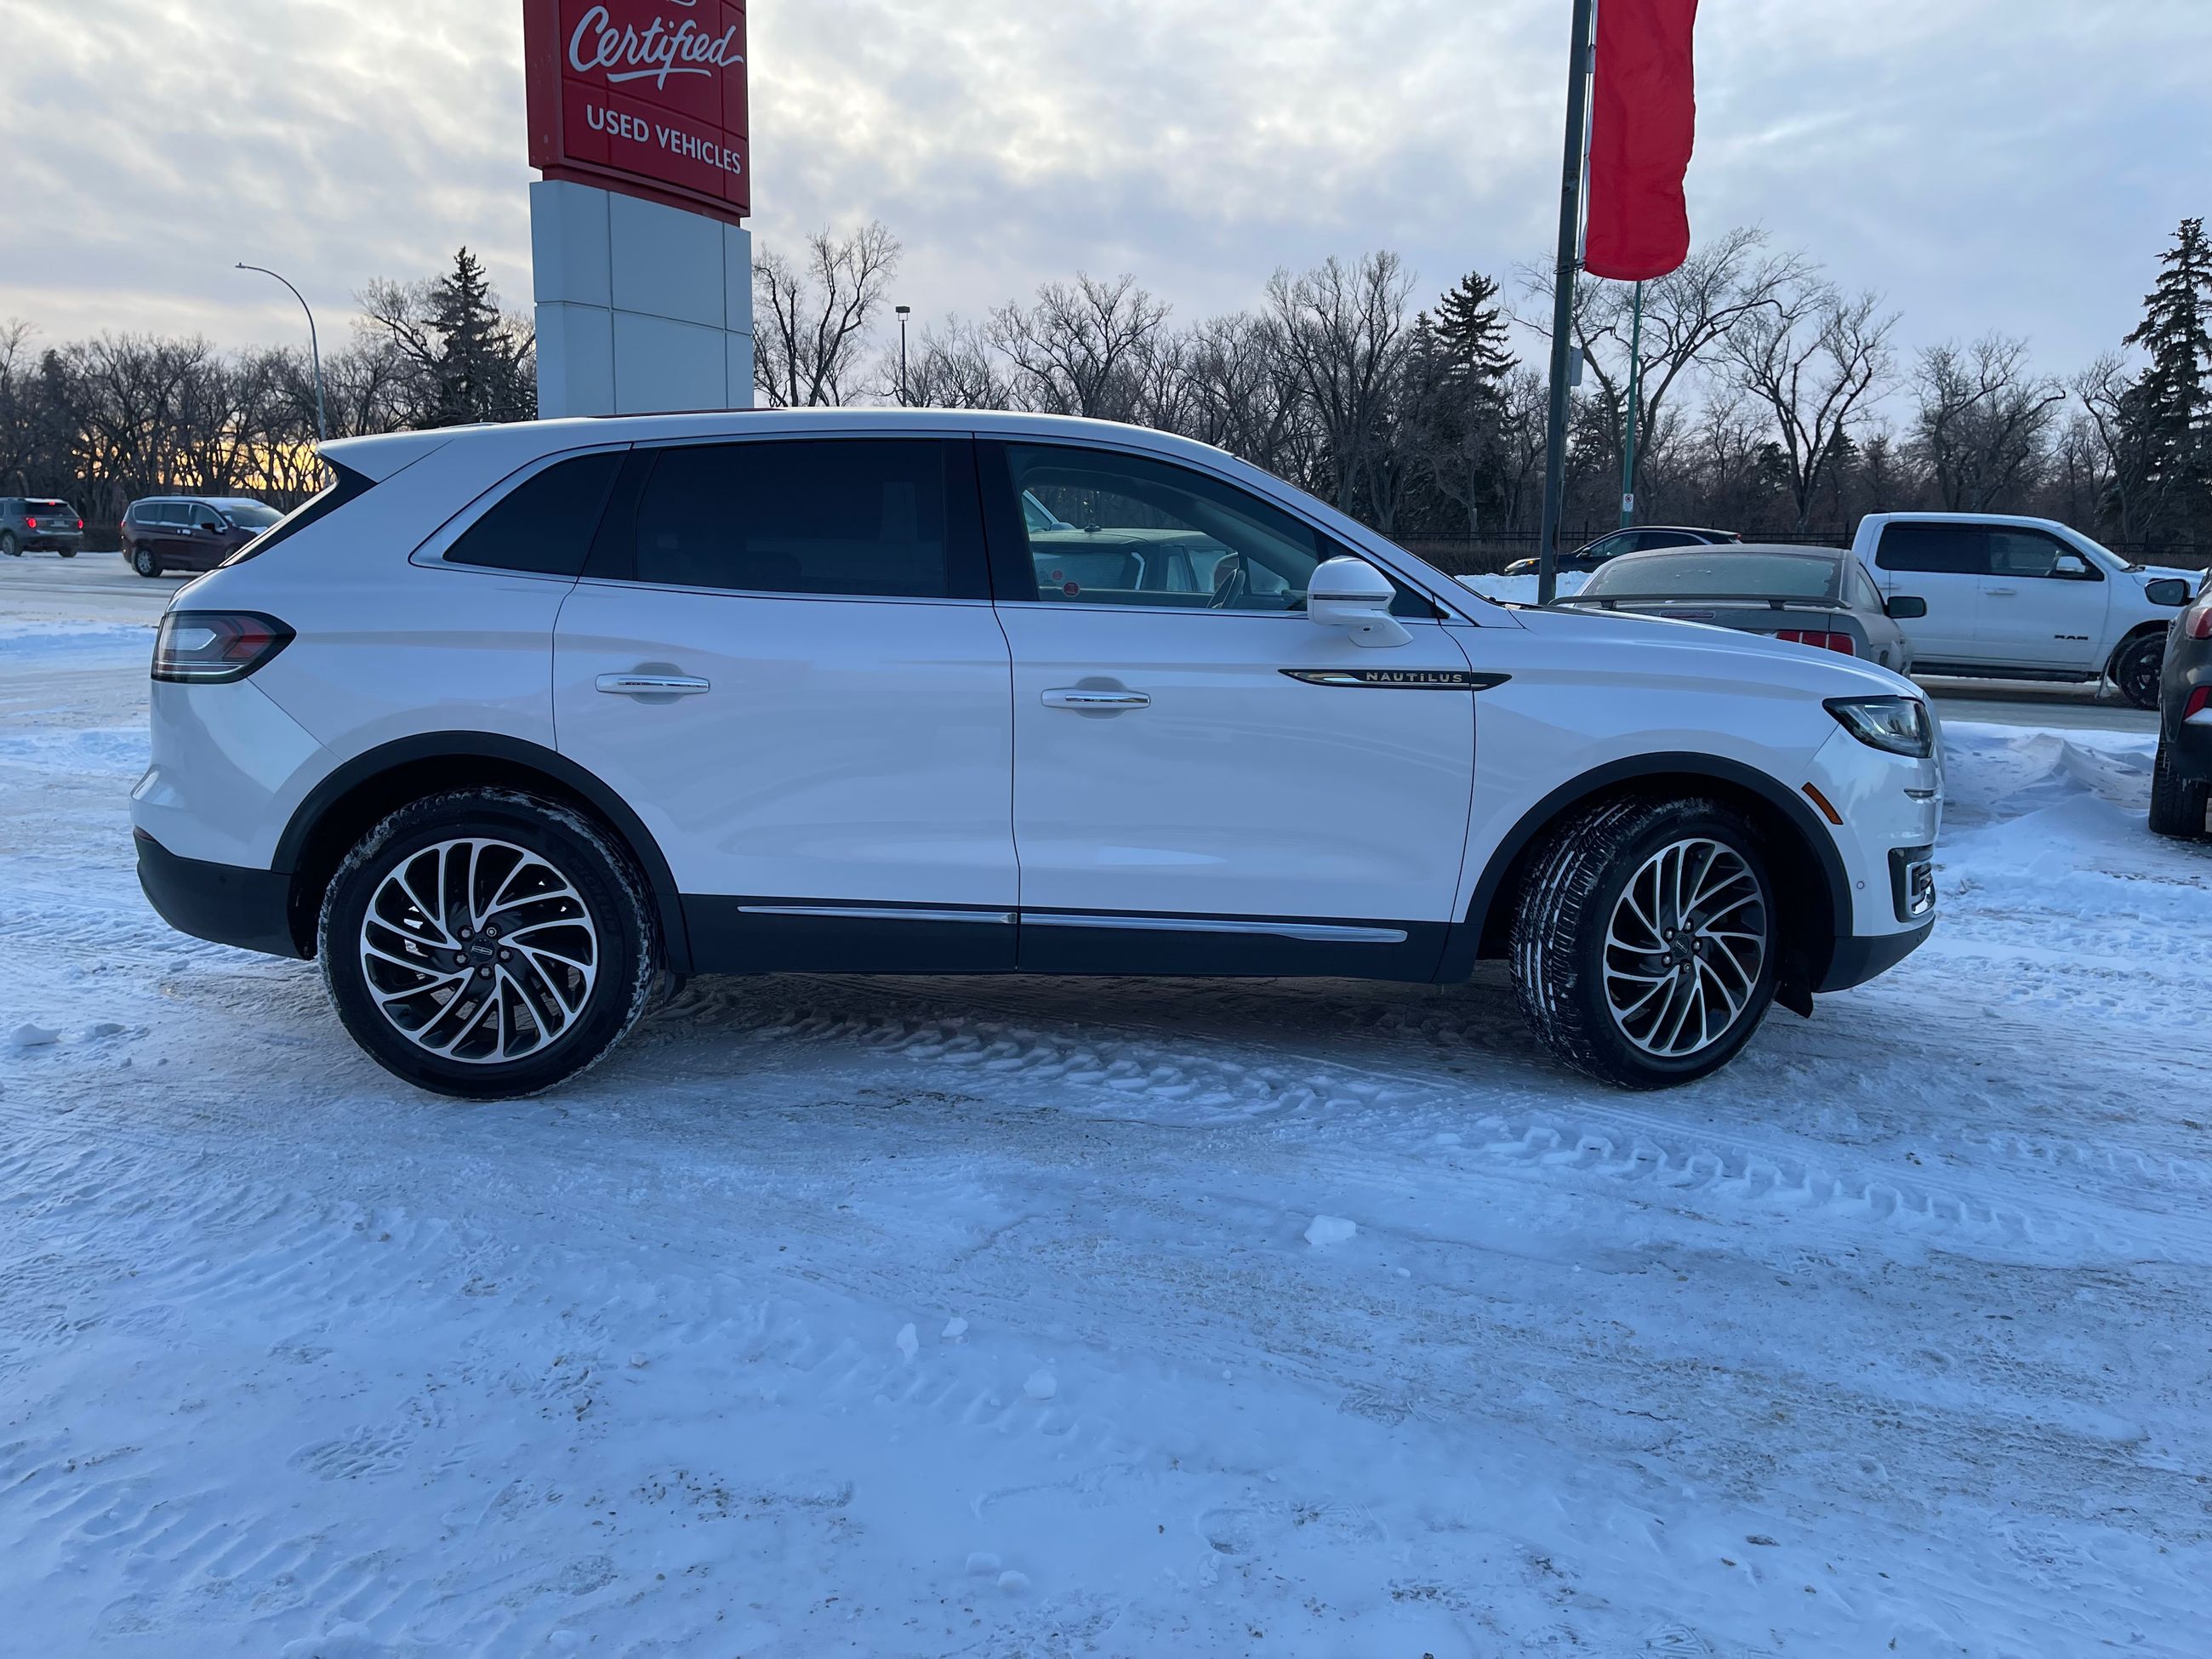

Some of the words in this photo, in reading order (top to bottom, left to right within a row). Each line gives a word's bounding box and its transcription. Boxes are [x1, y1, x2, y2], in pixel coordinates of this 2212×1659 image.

[568, 5, 744, 91] Certified
[586, 103, 649, 143] USED
[655, 123, 741, 175] VEHICLES
[1365, 671, 1463, 683] NAUTILUS
